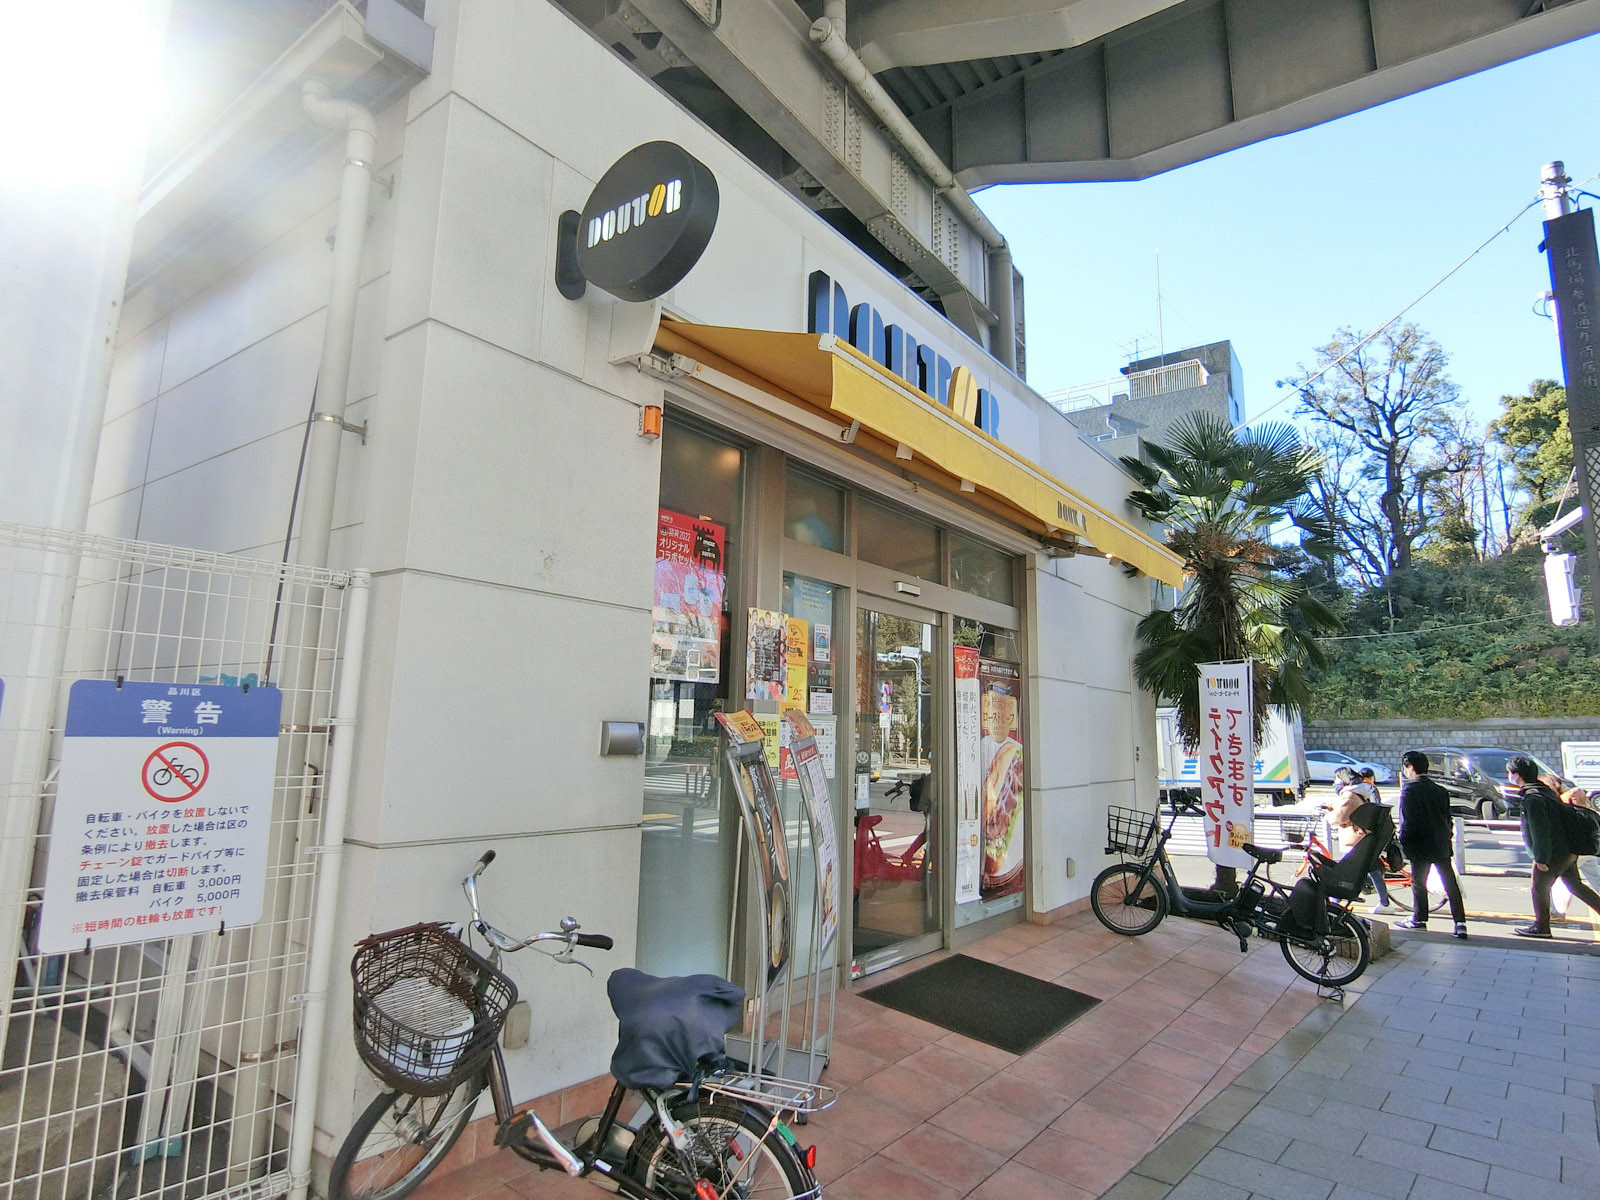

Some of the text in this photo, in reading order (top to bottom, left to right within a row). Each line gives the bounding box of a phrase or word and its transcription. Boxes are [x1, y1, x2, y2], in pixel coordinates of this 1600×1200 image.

[587, 179, 682, 249] DOUTOR
[659, 537, 690, 553] オリジナル
[167, 687, 202, 696] 品川区
[140, 699, 223, 724] 警告
[157, 726, 203, 736] (Warning)
[75, 874, 242, 902] 撤去保管料 自転車 3,000円
[149, 888, 240, 908] バイク 5,000円
